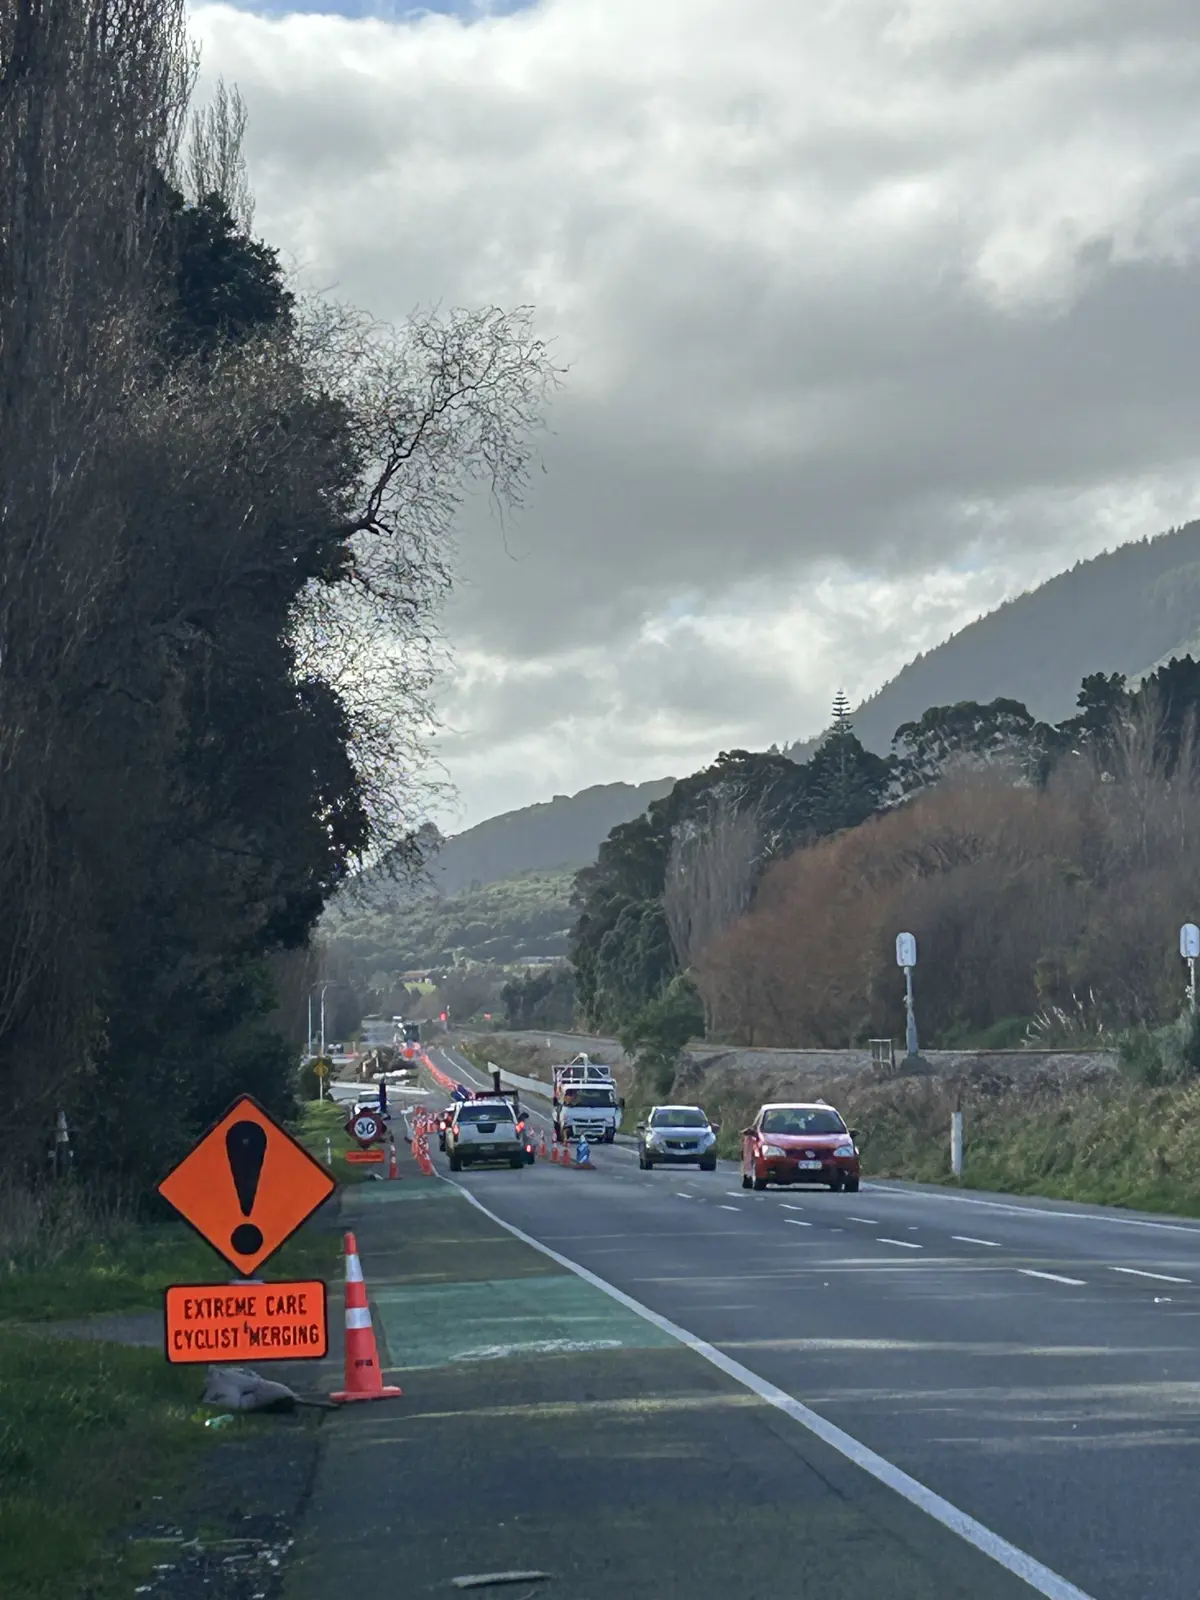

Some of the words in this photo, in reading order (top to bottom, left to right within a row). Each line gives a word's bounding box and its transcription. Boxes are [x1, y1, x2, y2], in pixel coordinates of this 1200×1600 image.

[357, 1122, 375, 1134] 30
[184, 1296, 256, 1319] EXTREME
[266, 1294, 307, 1316] CARE
[174, 1327, 238, 1350] CYCLIST
[249, 1324, 319, 1346] MERGING
